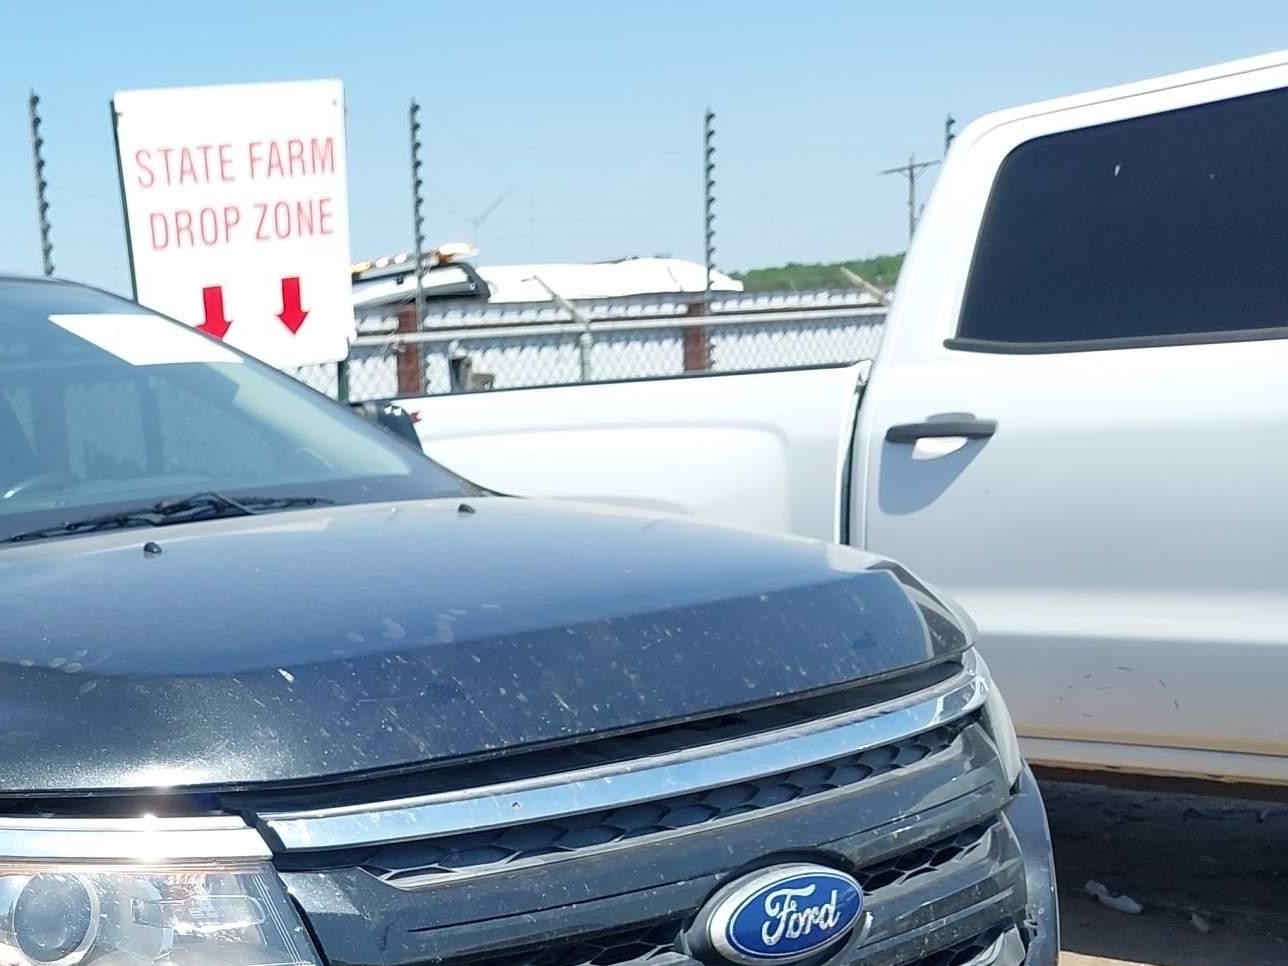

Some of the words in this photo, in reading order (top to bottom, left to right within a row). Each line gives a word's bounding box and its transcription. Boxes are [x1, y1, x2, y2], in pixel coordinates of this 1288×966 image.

[135, 143, 235, 189] STATE
[248, 136, 335, 180] FARM
[149, 206, 241, 251] DROP
[254, 197, 333, 241] ZONE
[762, 884, 840, 946] Ford
